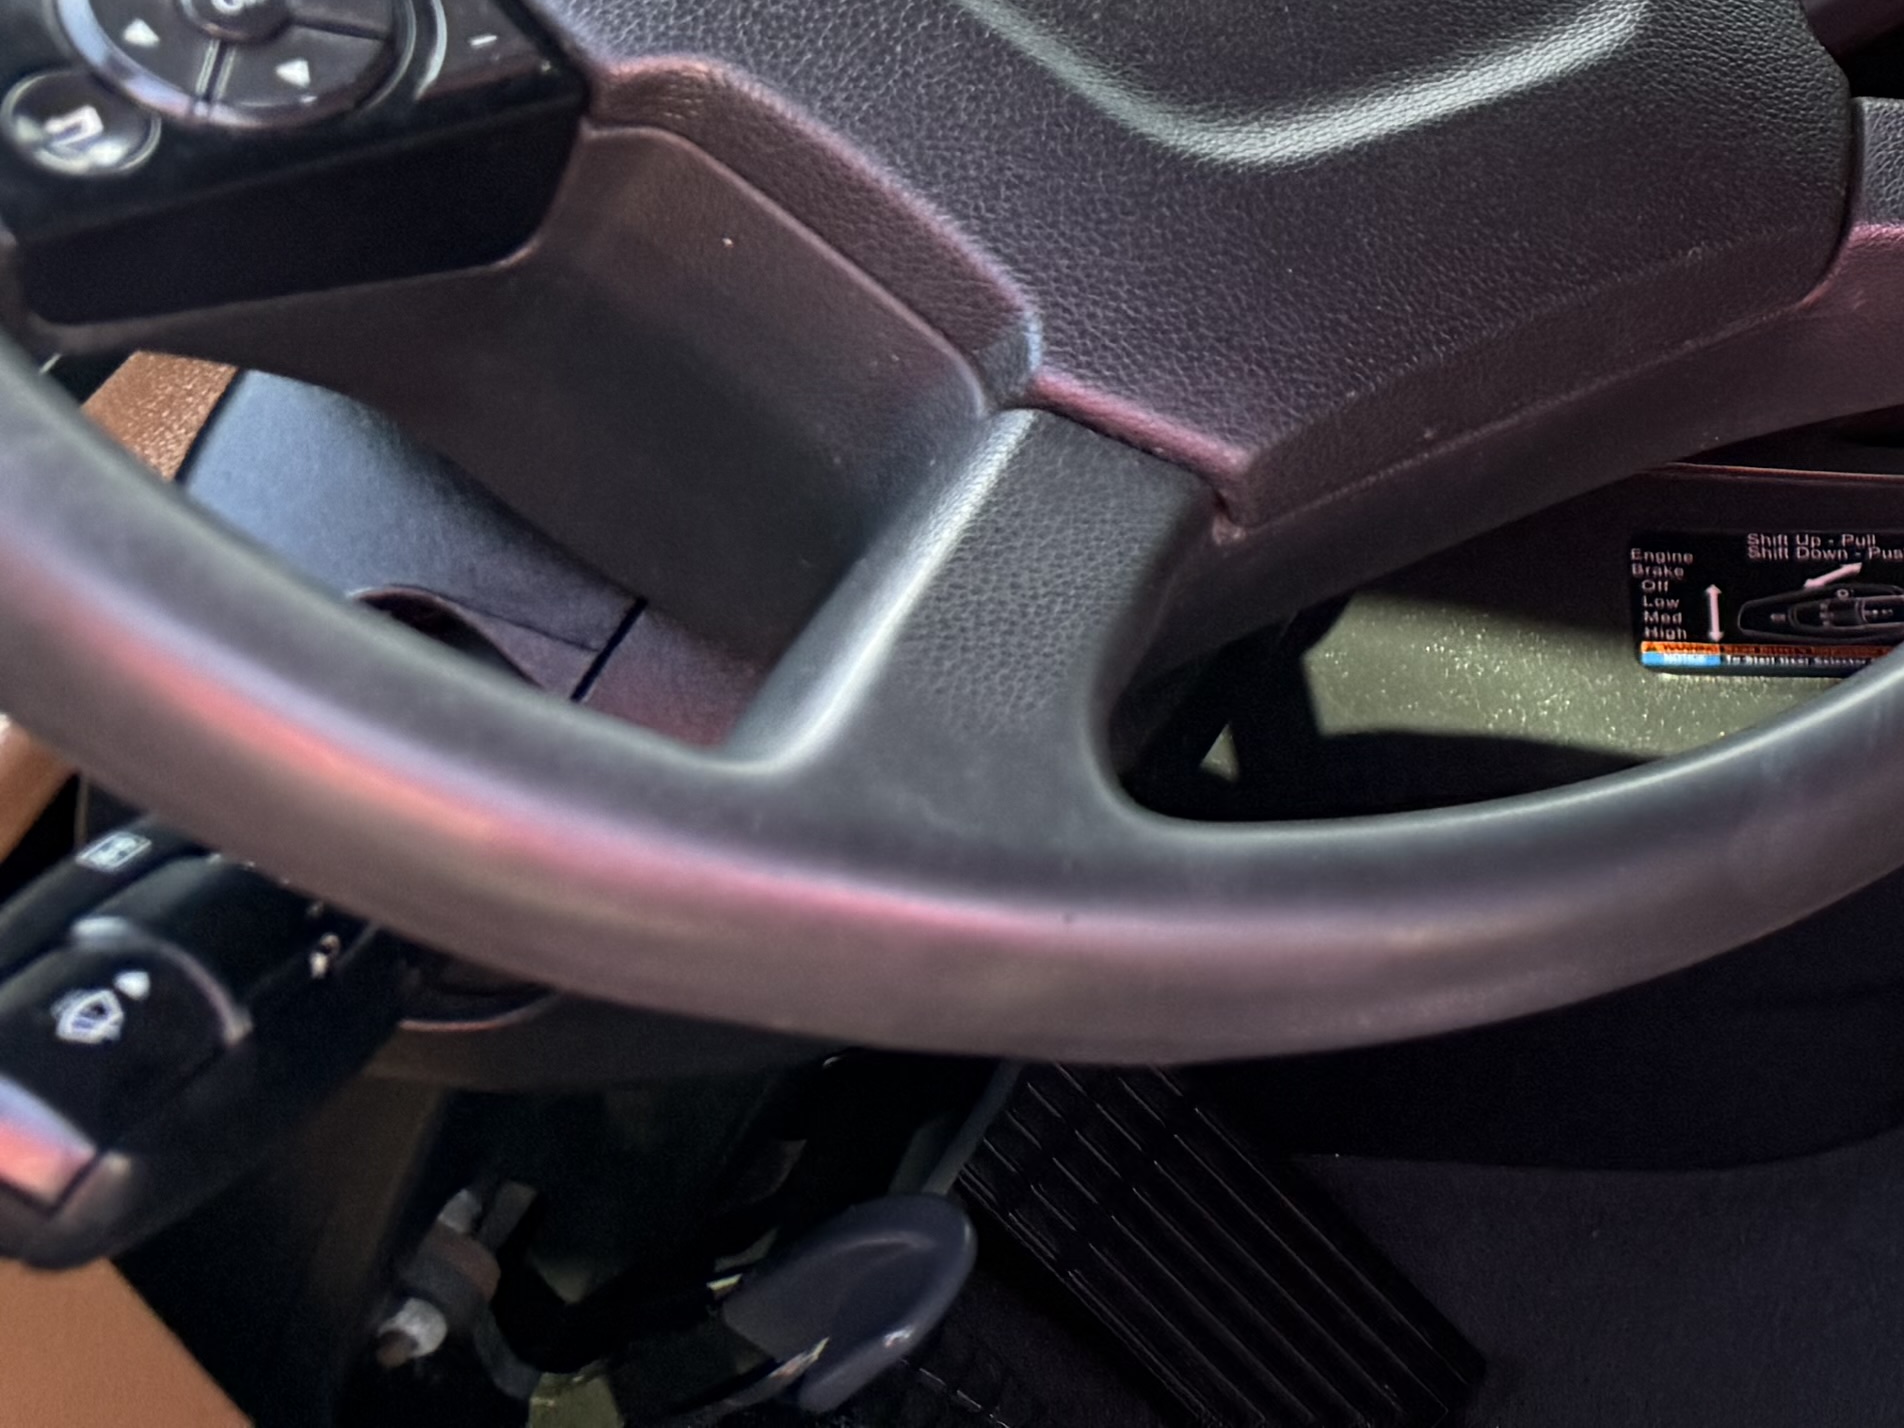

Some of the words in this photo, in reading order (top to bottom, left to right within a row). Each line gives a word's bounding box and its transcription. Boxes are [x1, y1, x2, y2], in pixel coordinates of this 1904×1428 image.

[1747, 533, 1788, 547] Shift
[1796, 534, 1821, 549] Up
[1841, 533, 1876, 547] Pull
[1630, 548, 1694, 564] Engine
[1748, 546, 1789, 560] Shift
[1796, 546, 1848, 560] Down
[1632, 563, 1685, 579] Brake
[1641, 579, 1669, 593] Off
[1642, 595, 1680, 609] Low
[1643, 610, 1683, 624] Med
[1644, 626, 1688, 640] High
